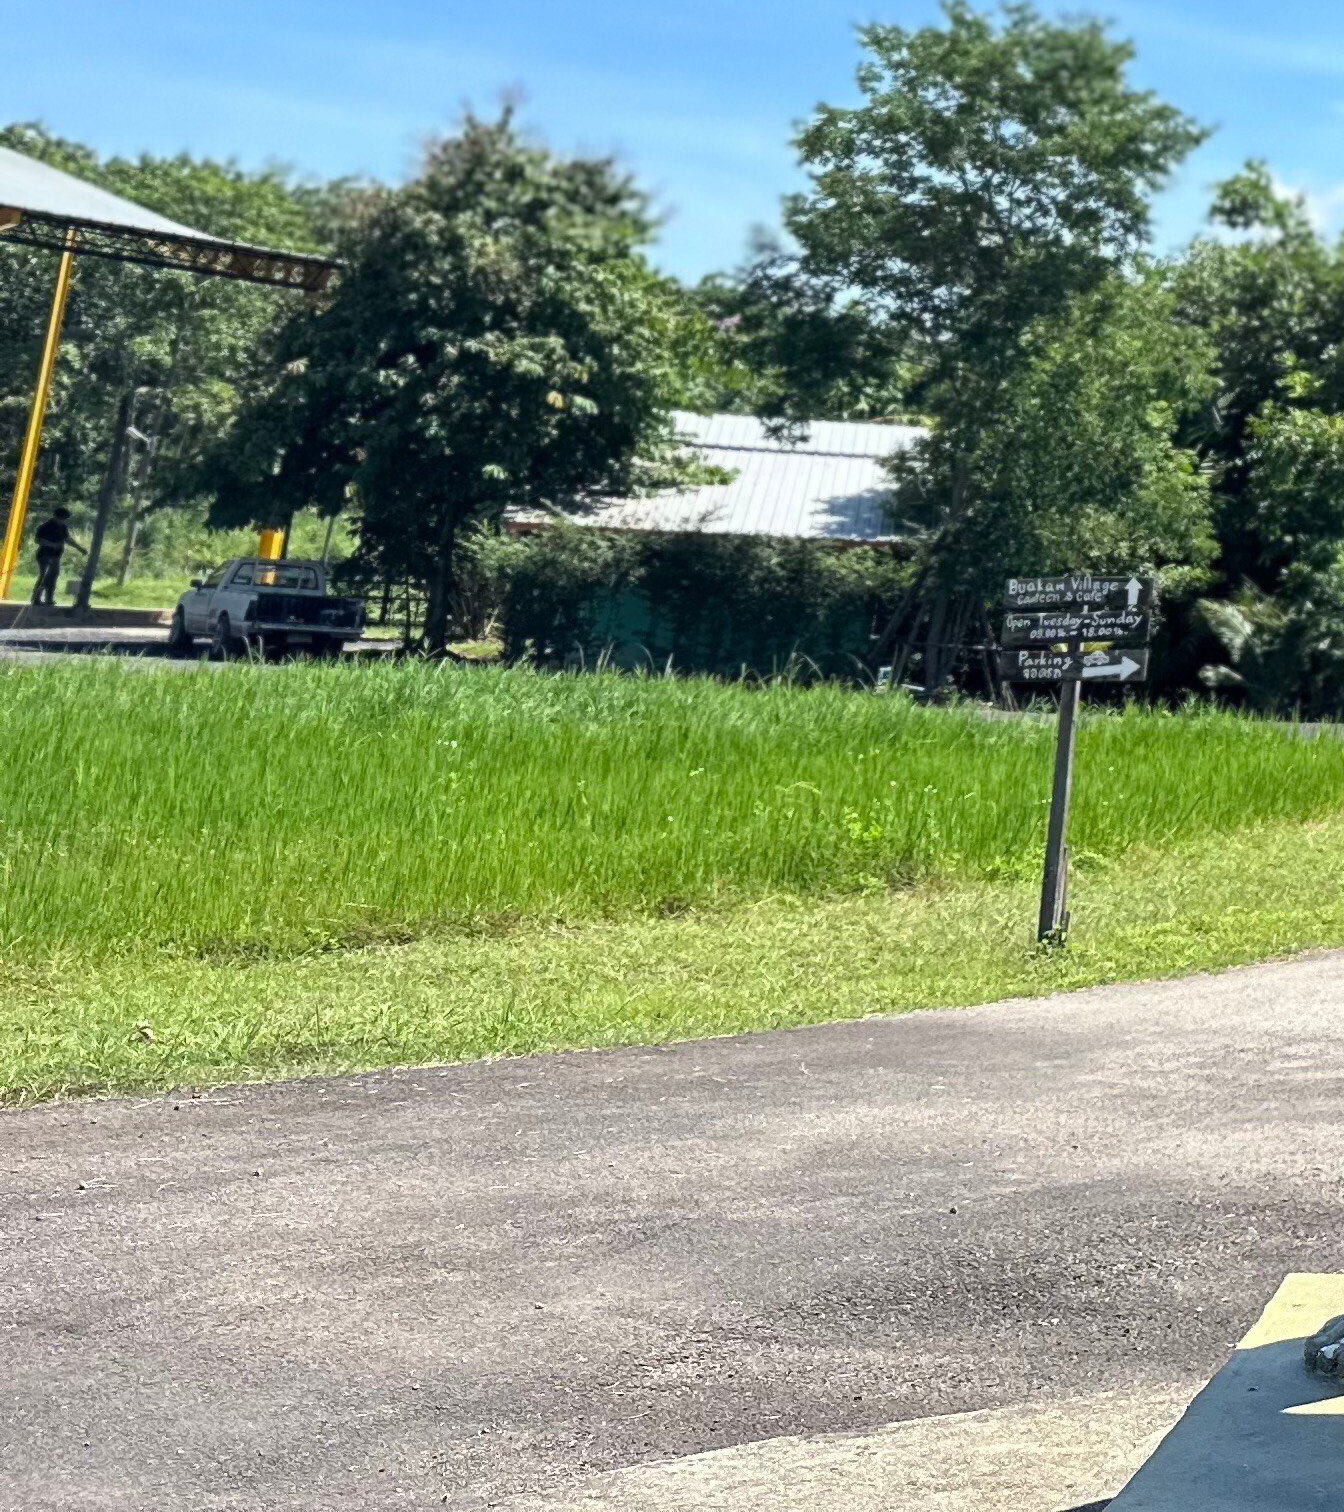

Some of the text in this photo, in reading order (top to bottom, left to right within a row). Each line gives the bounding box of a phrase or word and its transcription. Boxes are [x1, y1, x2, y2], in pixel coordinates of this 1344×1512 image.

[1070, 575, 1119, 595] Village
[1006, 613, 1031, 632] Open
[1018, 650, 1074, 670] Parking
